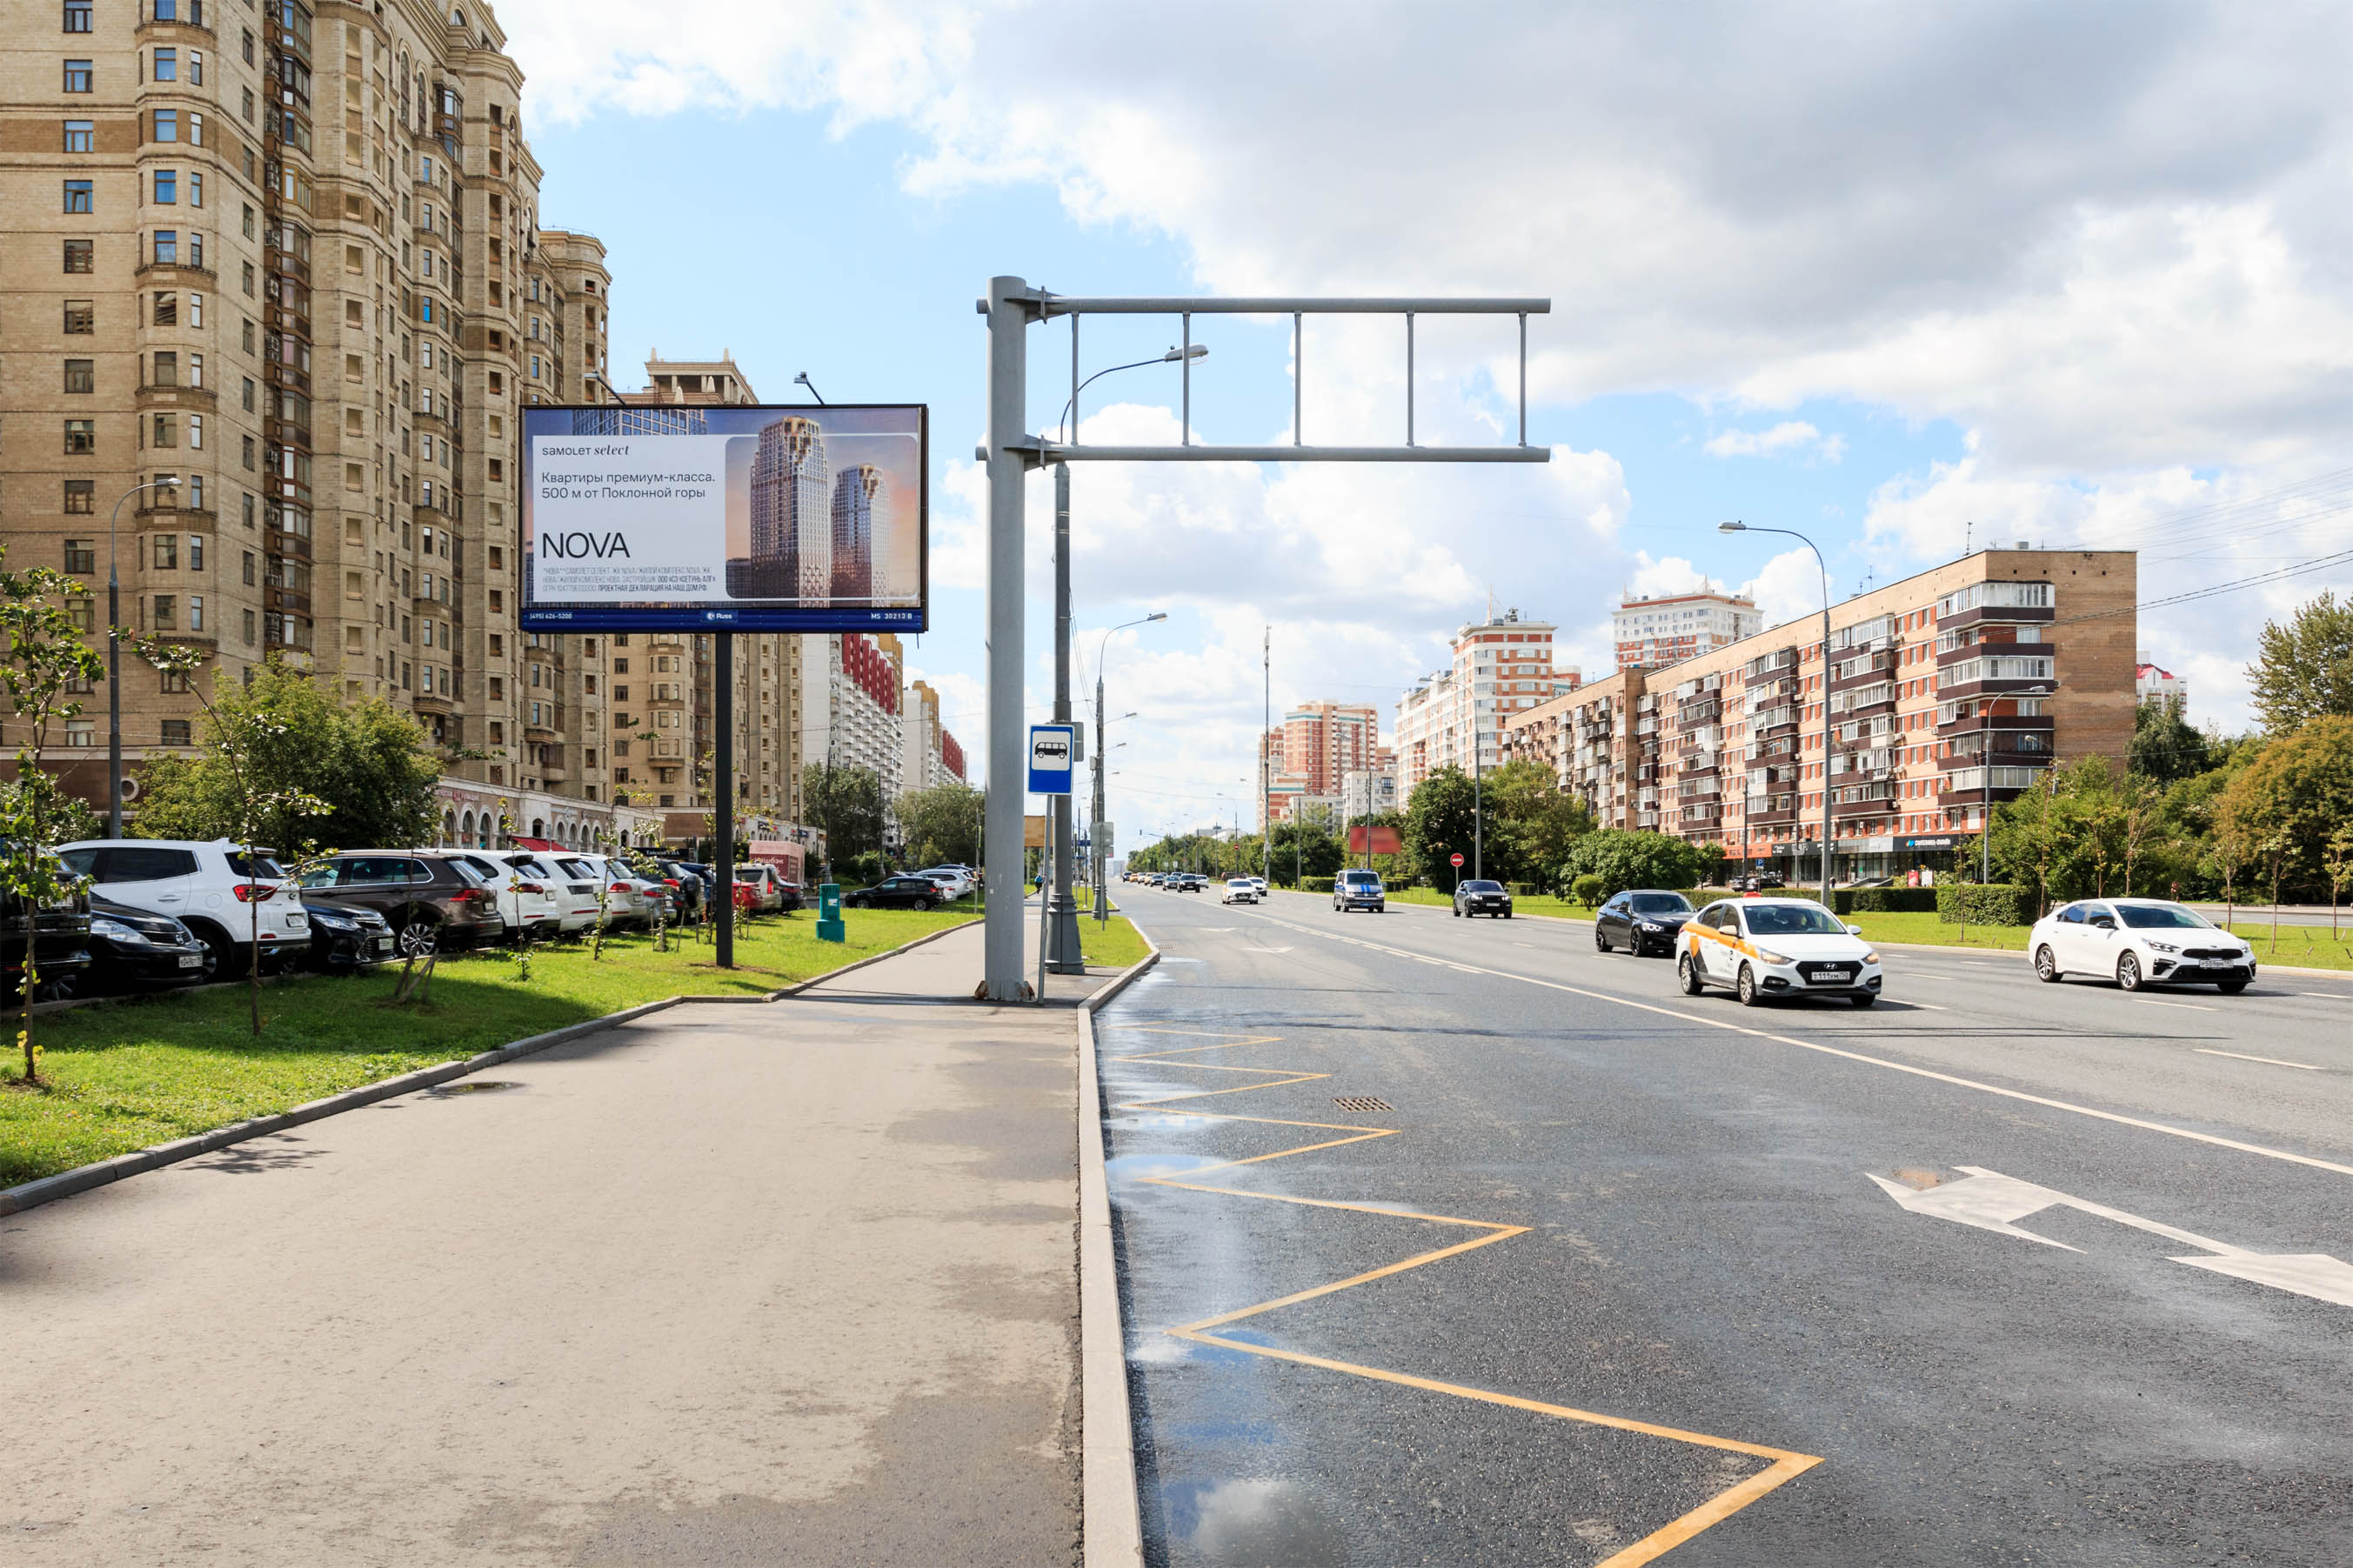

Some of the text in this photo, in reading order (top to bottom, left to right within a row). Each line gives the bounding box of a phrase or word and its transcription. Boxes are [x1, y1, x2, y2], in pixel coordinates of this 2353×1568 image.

[593, 444, 629, 456] select
[542, 472, 715, 484] Квартиры премиум-класса.
[542, 487, 705, 500] 500 м от Поклонной горы
[542, 532, 631, 558] NOVA
